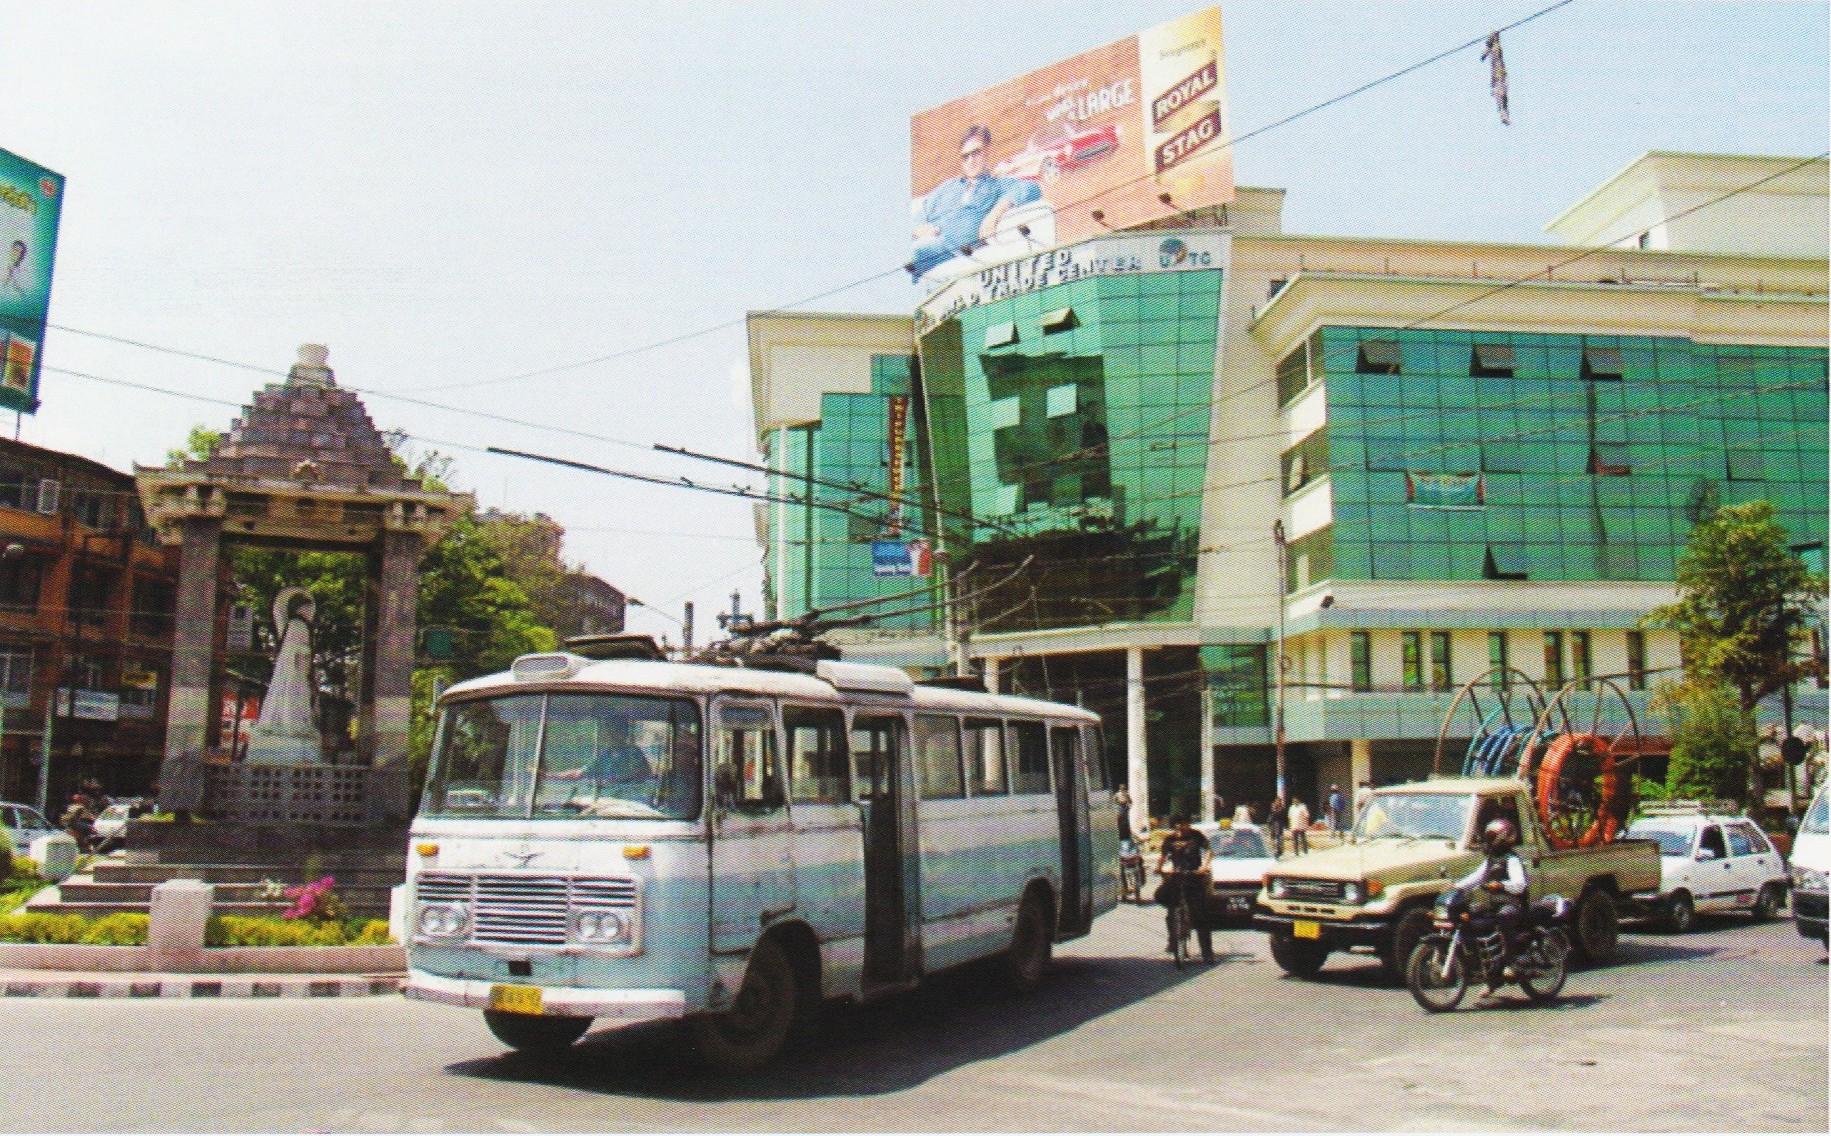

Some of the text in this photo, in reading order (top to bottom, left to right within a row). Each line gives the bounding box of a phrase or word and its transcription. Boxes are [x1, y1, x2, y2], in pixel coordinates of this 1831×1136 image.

[1078, 78, 1135, 121] LARGE
[1156, 68, 1214, 119] ROYAL
[1162, 119, 1213, 164] STAG
[979, 248, 1072, 288] UNITED
[1057, 256, 1143, 282] CENTER
